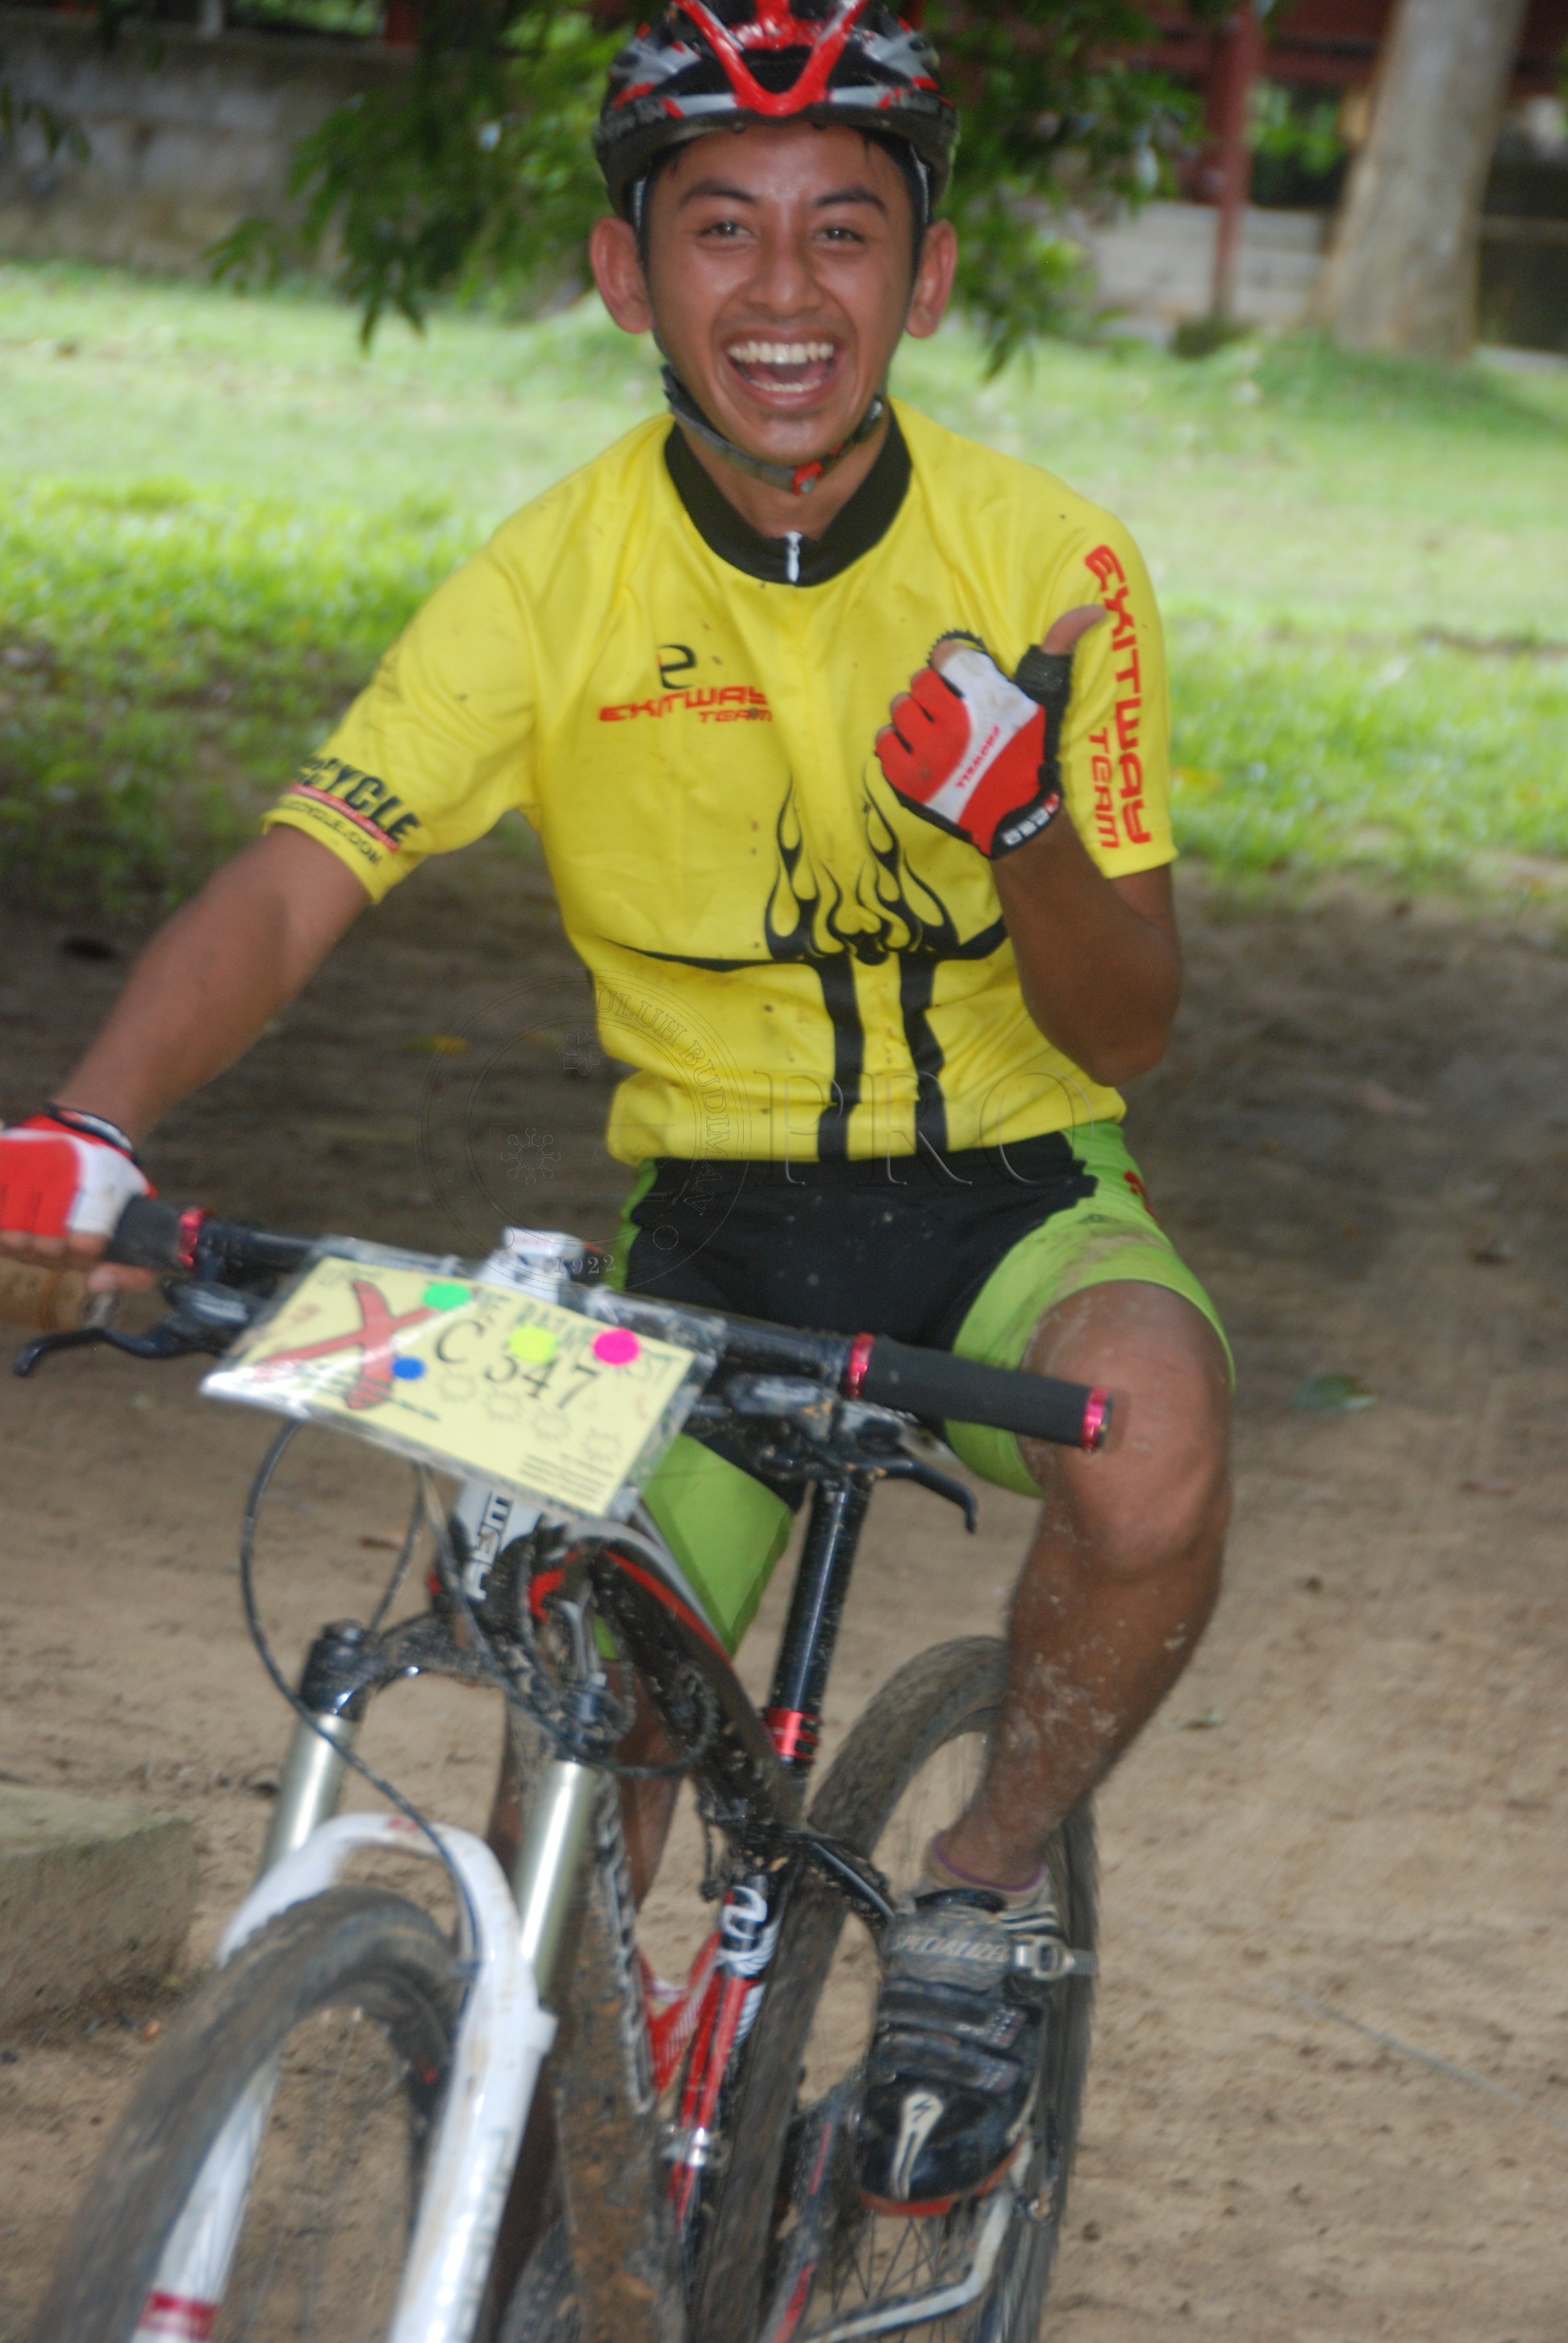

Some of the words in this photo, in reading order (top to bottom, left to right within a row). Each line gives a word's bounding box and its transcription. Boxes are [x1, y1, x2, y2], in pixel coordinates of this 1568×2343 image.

[698, 708, 773, 724] TEAM
[1084, 544, 1153, 845] EXITWAY
[1088, 726, 1120, 849] TEAM
[436, 1319, 486, 1364] C
